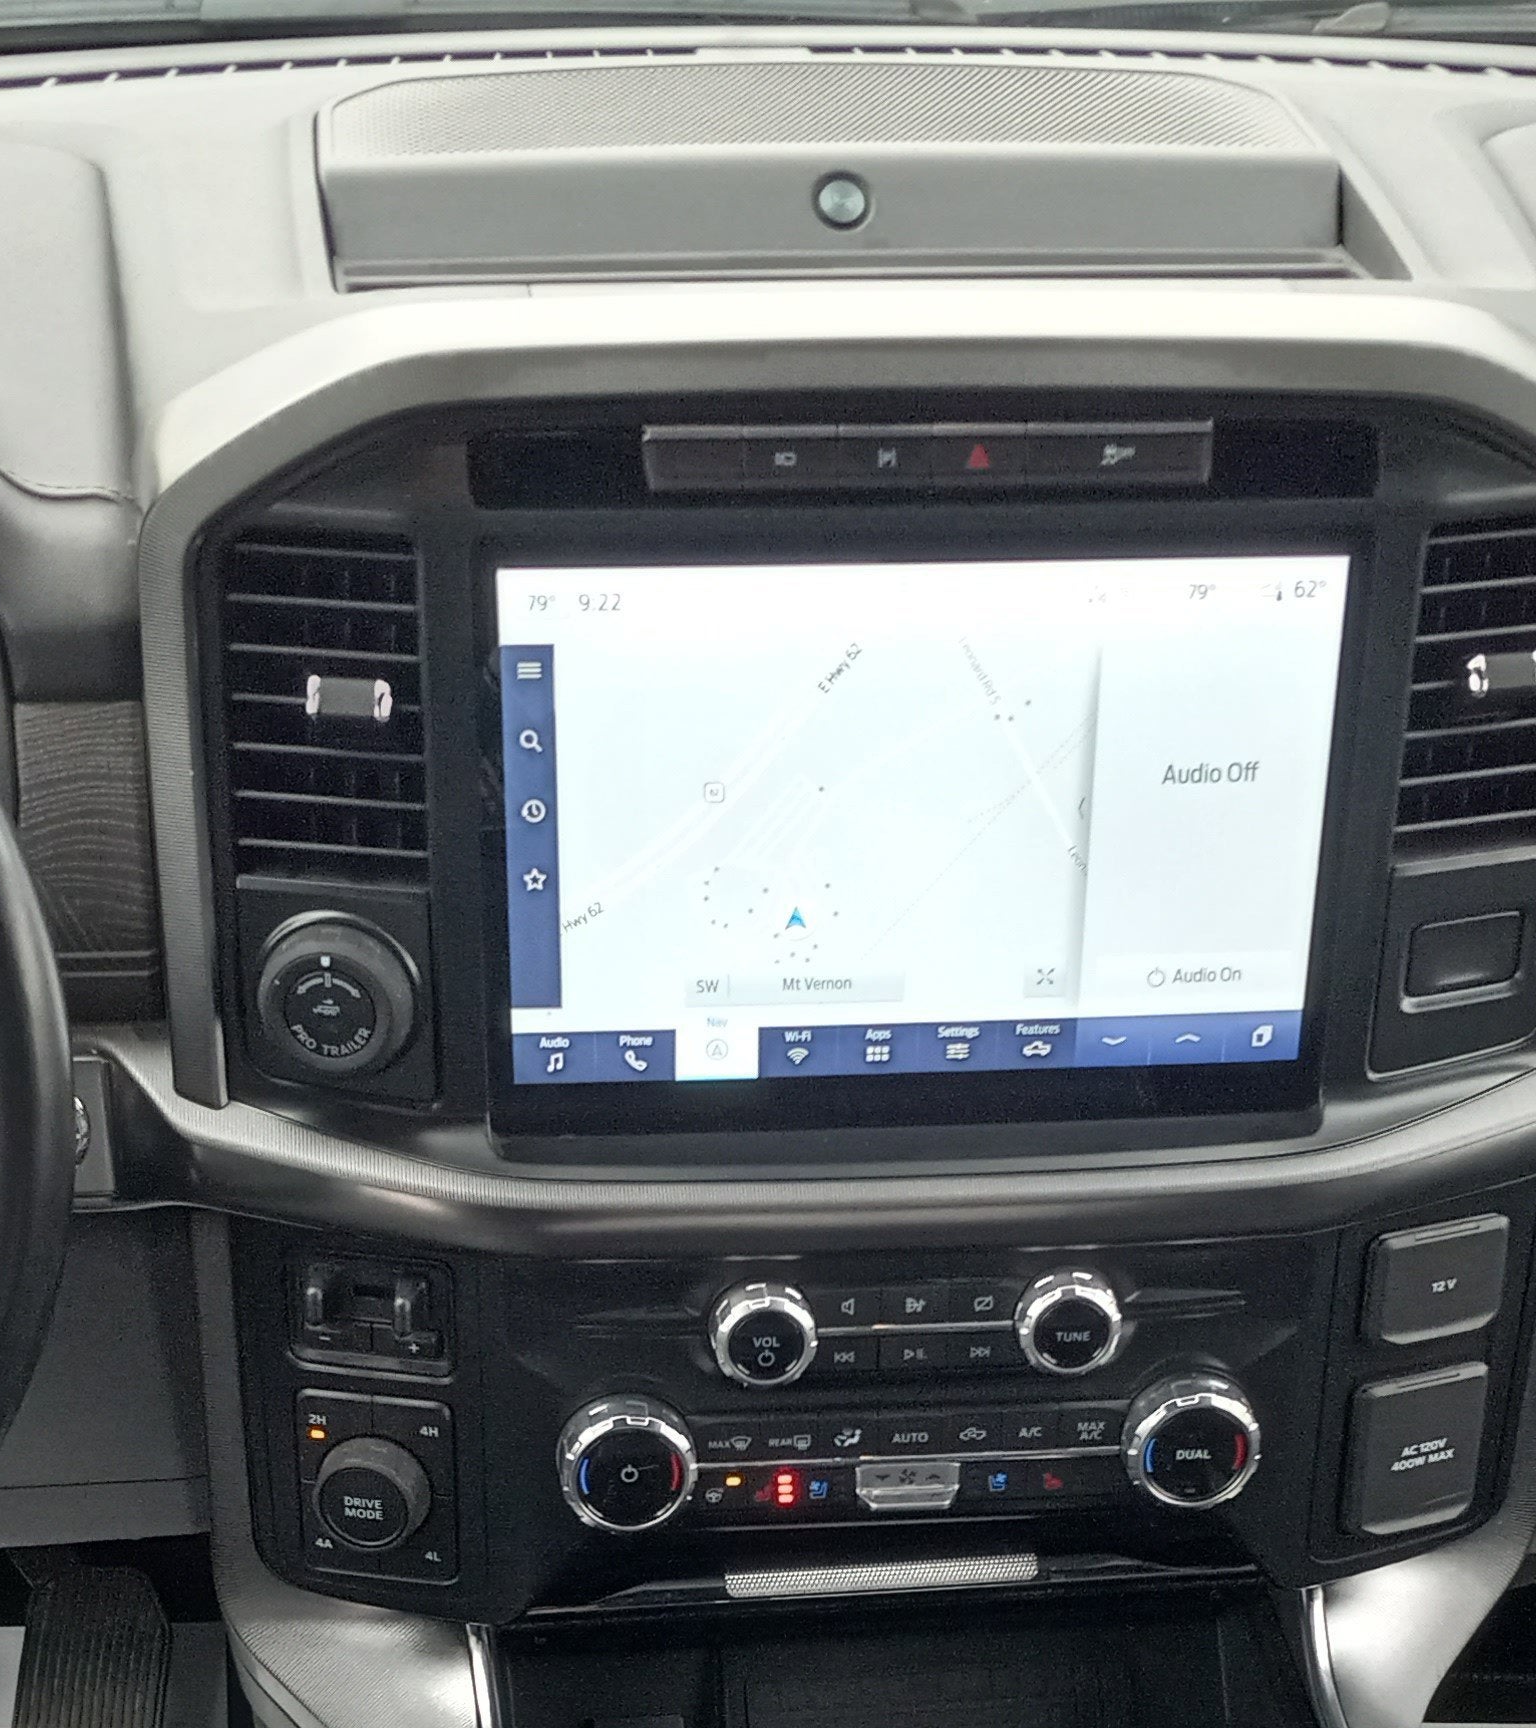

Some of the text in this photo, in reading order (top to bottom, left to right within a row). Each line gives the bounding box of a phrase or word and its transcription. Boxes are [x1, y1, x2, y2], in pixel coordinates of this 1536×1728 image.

[1161, 760, 1260, 785] Audio Off
[1171, 965, 1242, 985] Audio On
[695, 978, 720, 995] SW
[782, 976, 852, 992] Mt Vernon
[864, 1028, 892, 1042] Apps
[937, 1024, 981, 1039] Settings
[1015, 1022, 1061, 1037] Features
[290, 1023, 373, 1057] PRO TRAILER
[538, 1036, 570, 1049] Audio
[618, 1034, 654, 1048] Phone
[752, 1336, 781, 1349] VOL
[1054, 1330, 1092, 1343] TUNE
[308, 1413, 327, 1427] 2H
[1076, 1420, 1106, 1433] MAX
[419, 1425, 440, 1439] 4H
[890, 1431, 929, 1445] AUTO
[1018, 1425, 1043, 1439] A/C
[1078, 1430, 1104, 1442] A/C
[768, 1436, 793, 1448] REAR
[1175, 1449, 1212, 1461] DUAL
[1426, 1448, 1456, 1466] MAX
[343, 1495, 384, 1510] DRIVE
[343, 1507, 385, 1521] MODE
[314, 1536, 333, 1550] 4A
[424, 1550, 442, 1563] 4L
